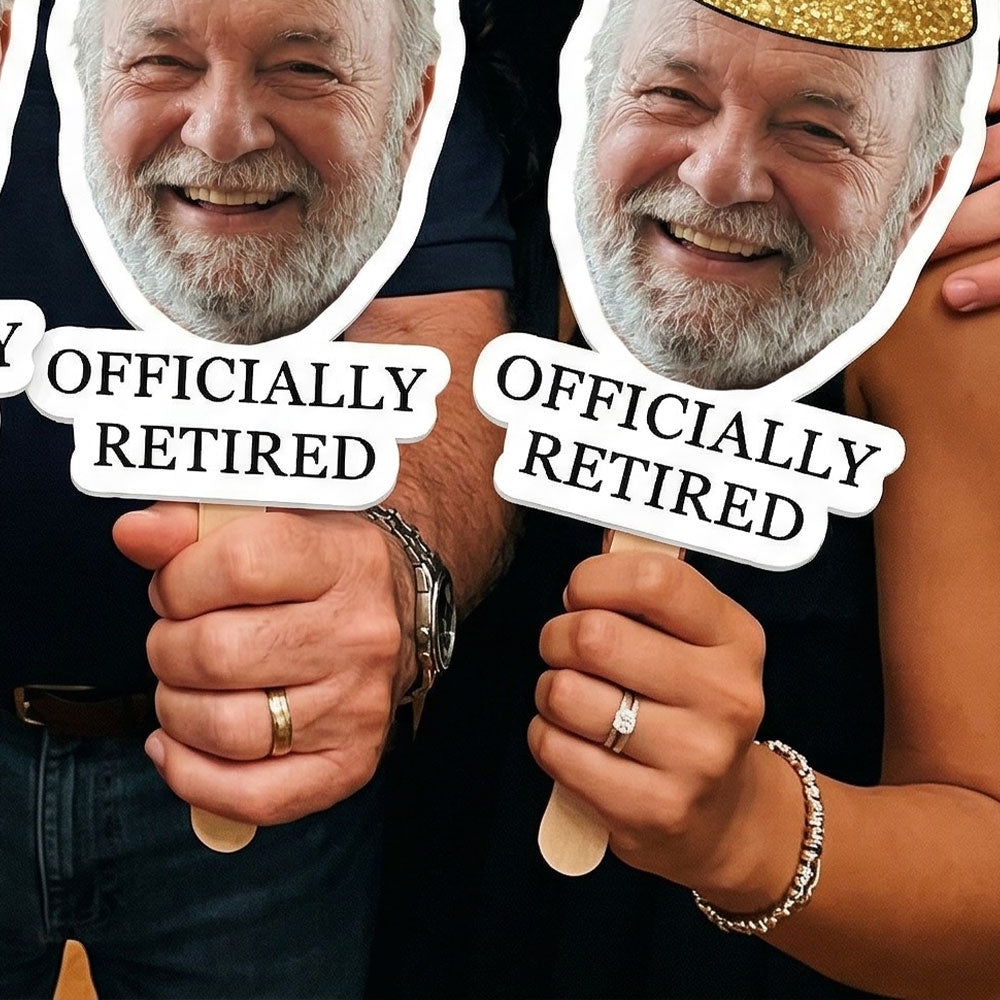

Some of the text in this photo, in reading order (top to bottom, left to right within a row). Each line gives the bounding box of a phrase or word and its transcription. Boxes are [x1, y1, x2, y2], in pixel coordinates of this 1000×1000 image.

[47, 348, 427, 412] OFFICIALLY
[497, 355, 882, 488] OFFICIALLY
[93, 422, 376, 481] RETIRED
[518, 429, 805, 541] RETIRED
